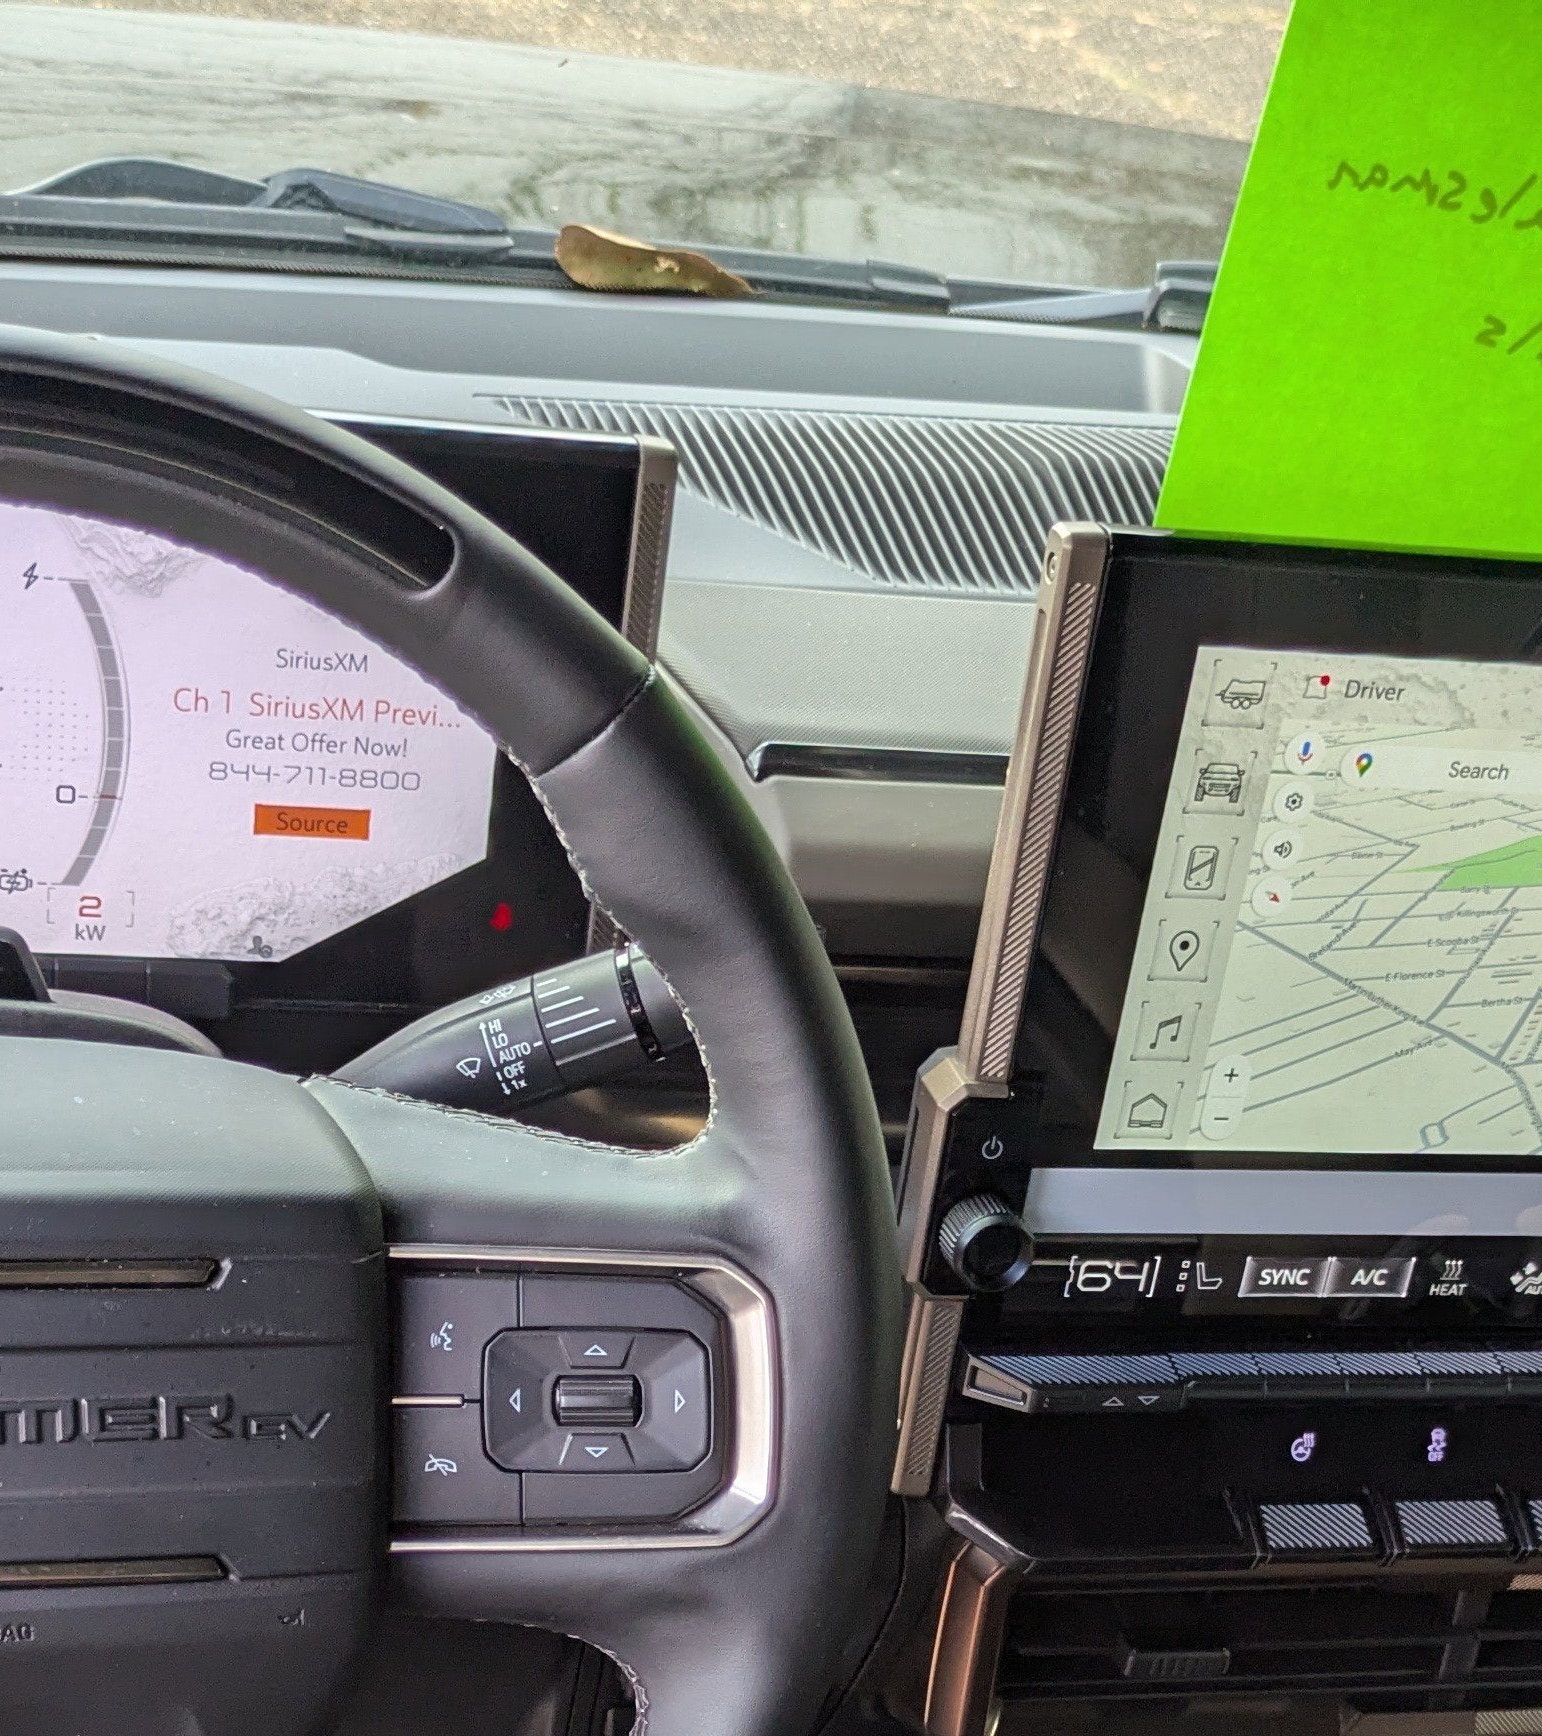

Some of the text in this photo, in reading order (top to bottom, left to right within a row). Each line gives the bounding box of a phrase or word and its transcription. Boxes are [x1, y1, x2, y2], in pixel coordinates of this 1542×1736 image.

[275, 647, 368, 674] SiriusXM
[1344, 679, 1405, 701] Driver
[172, 688, 461, 729] Ch 1 SiriusXM Previ...
[224, 729, 409, 759] Great Offer Now!
[208, 761, 422, 794] 844-711-8800
[1448, 760, 1509, 783] Search
[275, 811, 350, 836] Source
[78, 895, 103, 920] 2
[75, 923, 106, 941] kW
[488, 1020, 504, 1034] HI
[493, 1033, 508, 1048] LO
[499, 1042, 533, 1063] AUTO
[504, 1062, 526, 1081] OFF
[1076, 1260, 1150, 1292] 64
[1259, 1267, 1310, 1287] SYNC
[1351, 1267, 1388, 1287] A/C
[1428, 1282, 1467, 1296] HEAT
[242, 1410, 331, 1442] EV
